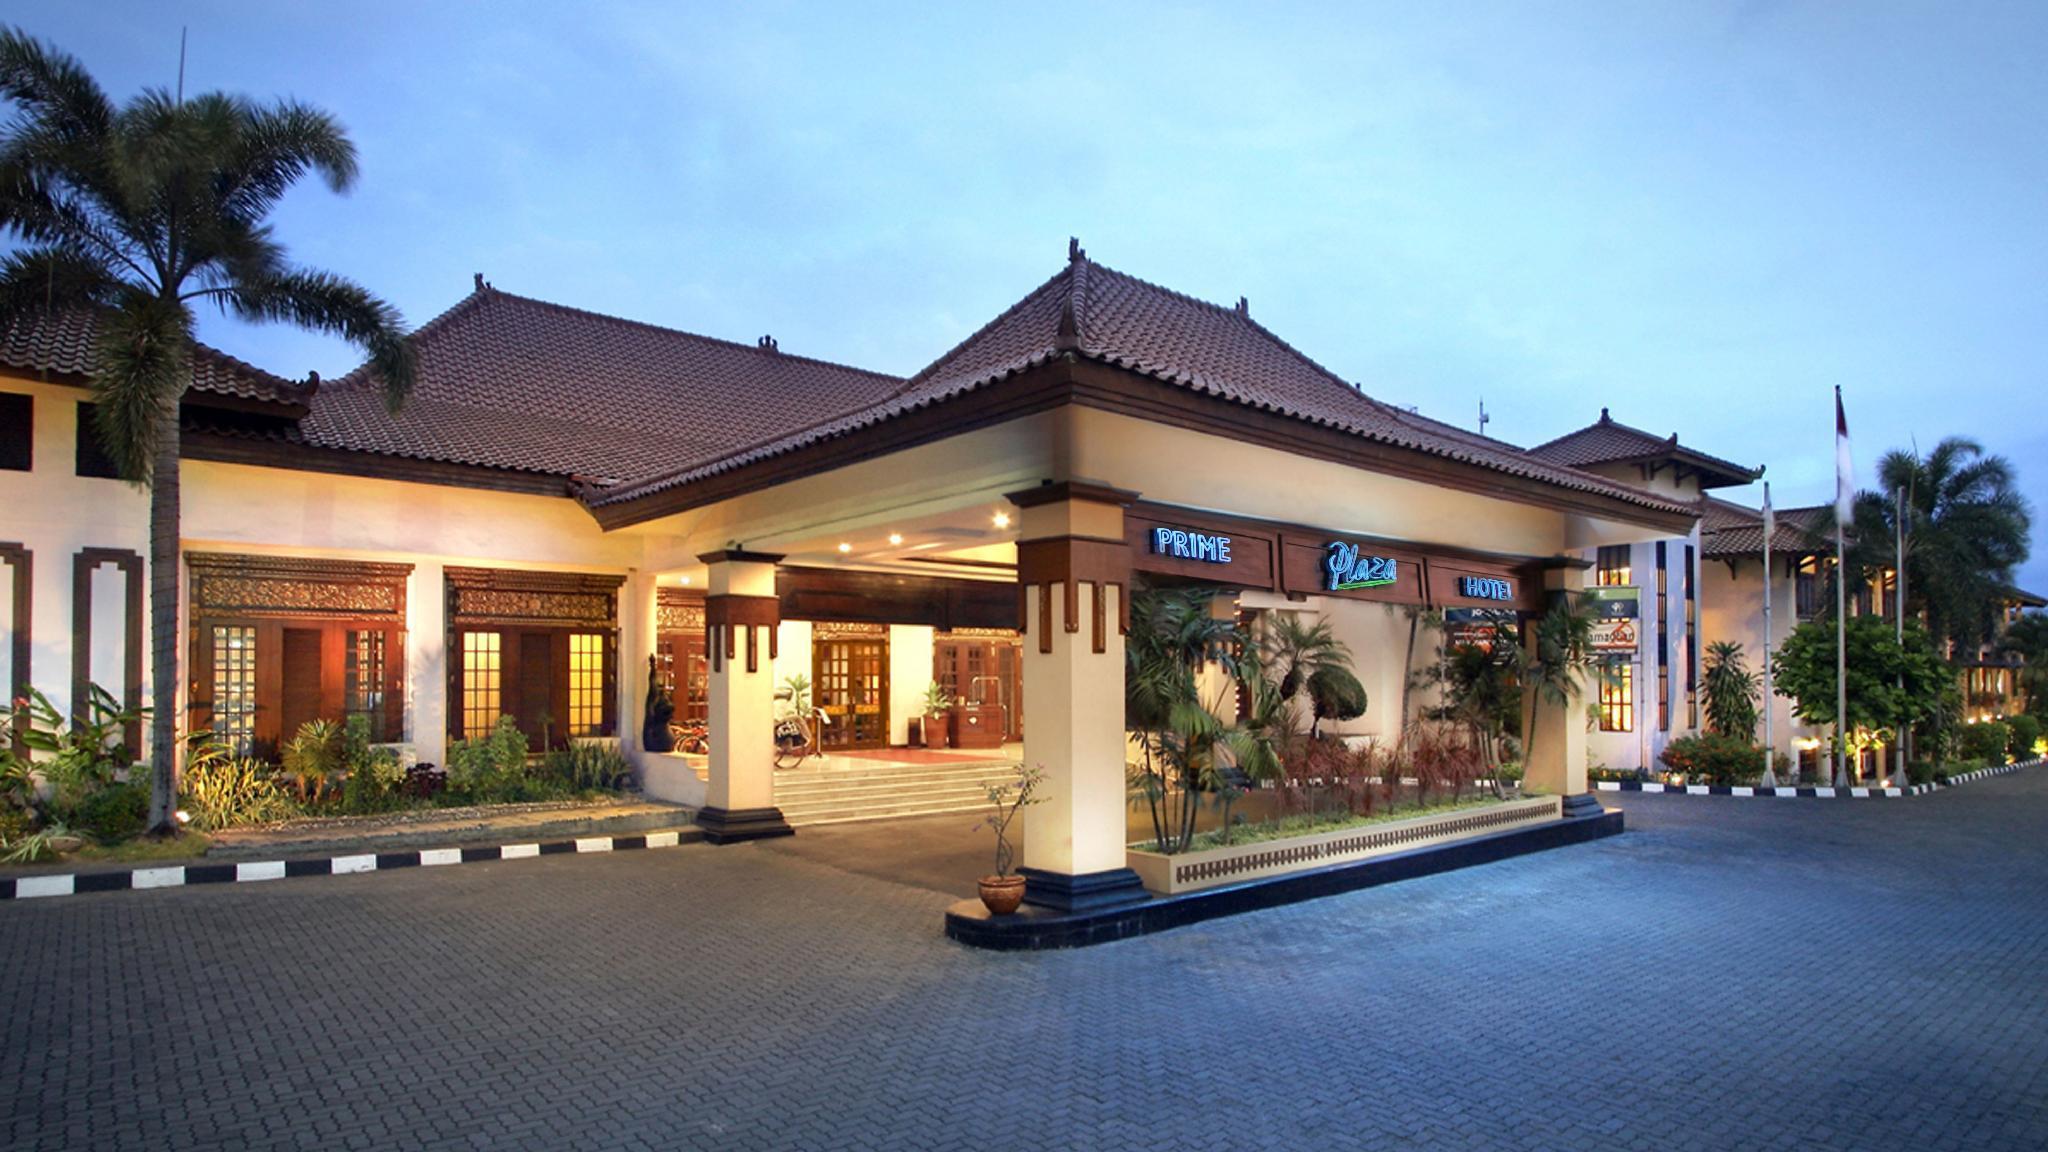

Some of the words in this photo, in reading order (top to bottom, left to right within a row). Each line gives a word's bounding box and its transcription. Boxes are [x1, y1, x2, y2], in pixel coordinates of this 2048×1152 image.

[1156, 527, 1232, 562] PRIME
[1328, 541, 1398, 591] Plaza
[1466, 575, 1514, 601] HOTEL
